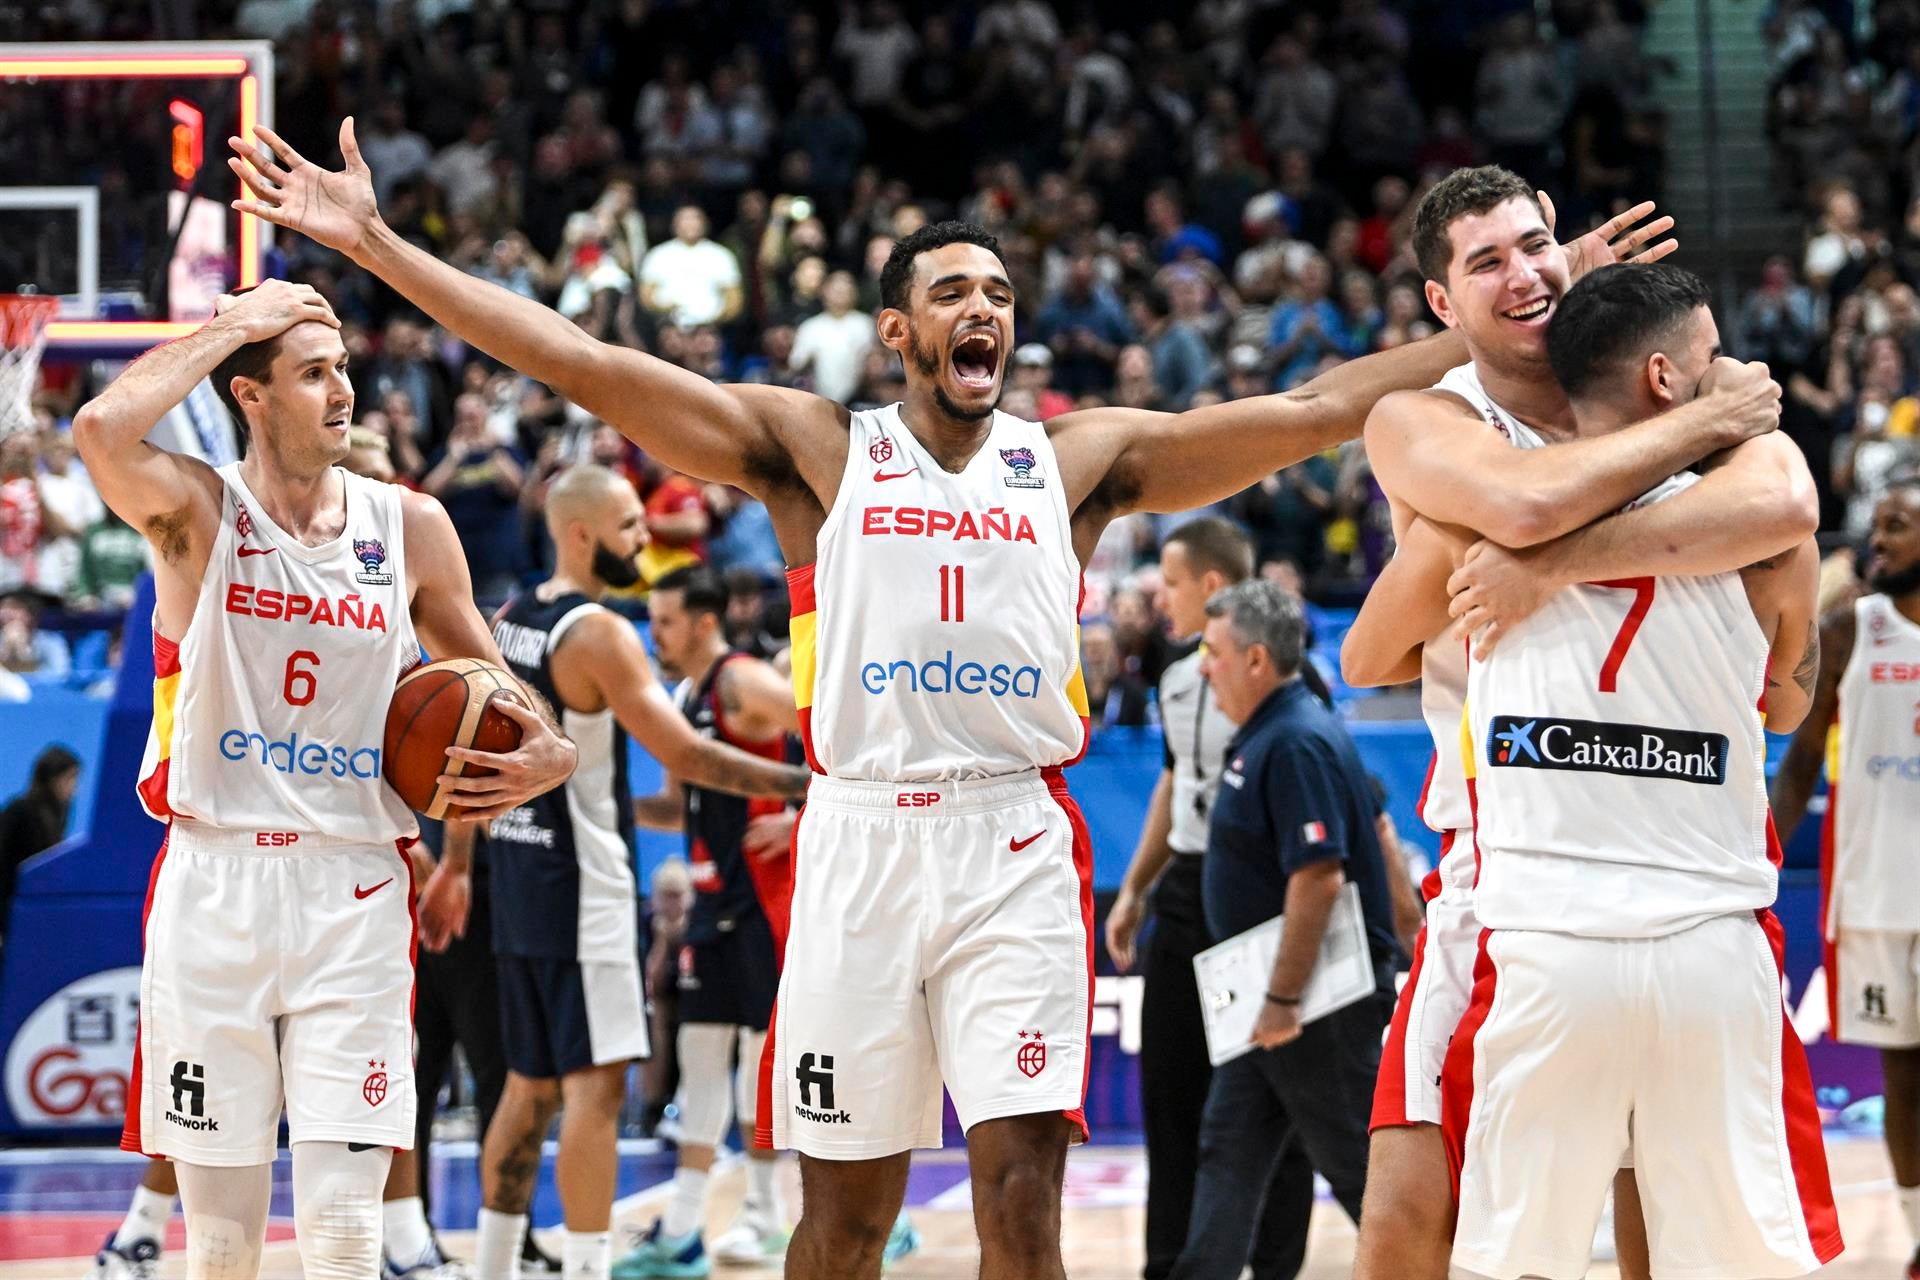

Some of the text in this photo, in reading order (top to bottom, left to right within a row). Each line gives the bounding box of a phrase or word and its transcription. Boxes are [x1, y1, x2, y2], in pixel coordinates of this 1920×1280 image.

[862, 506, 1038, 544] ESPAÑA
[225, 582, 387, 633] ESPAÑA
[938, 564, 964, 622] 11
[1583, 575, 1656, 692] 7
[283, 649, 320, 707] 6
[861, 650, 1042, 699] endesa
[219, 729, 381, 779] endesa
[1539, 724, 1718, 778] CaixaBank
[897, 792, 941, 807] ESP
[256, 832, 299, 846] ESP
[170, 1060, 205, 1117] fi
[796, 1052, 835, 1110] fi
[165, 1110, 219, 1131] network
[795, 1105, 852, 1124] network
